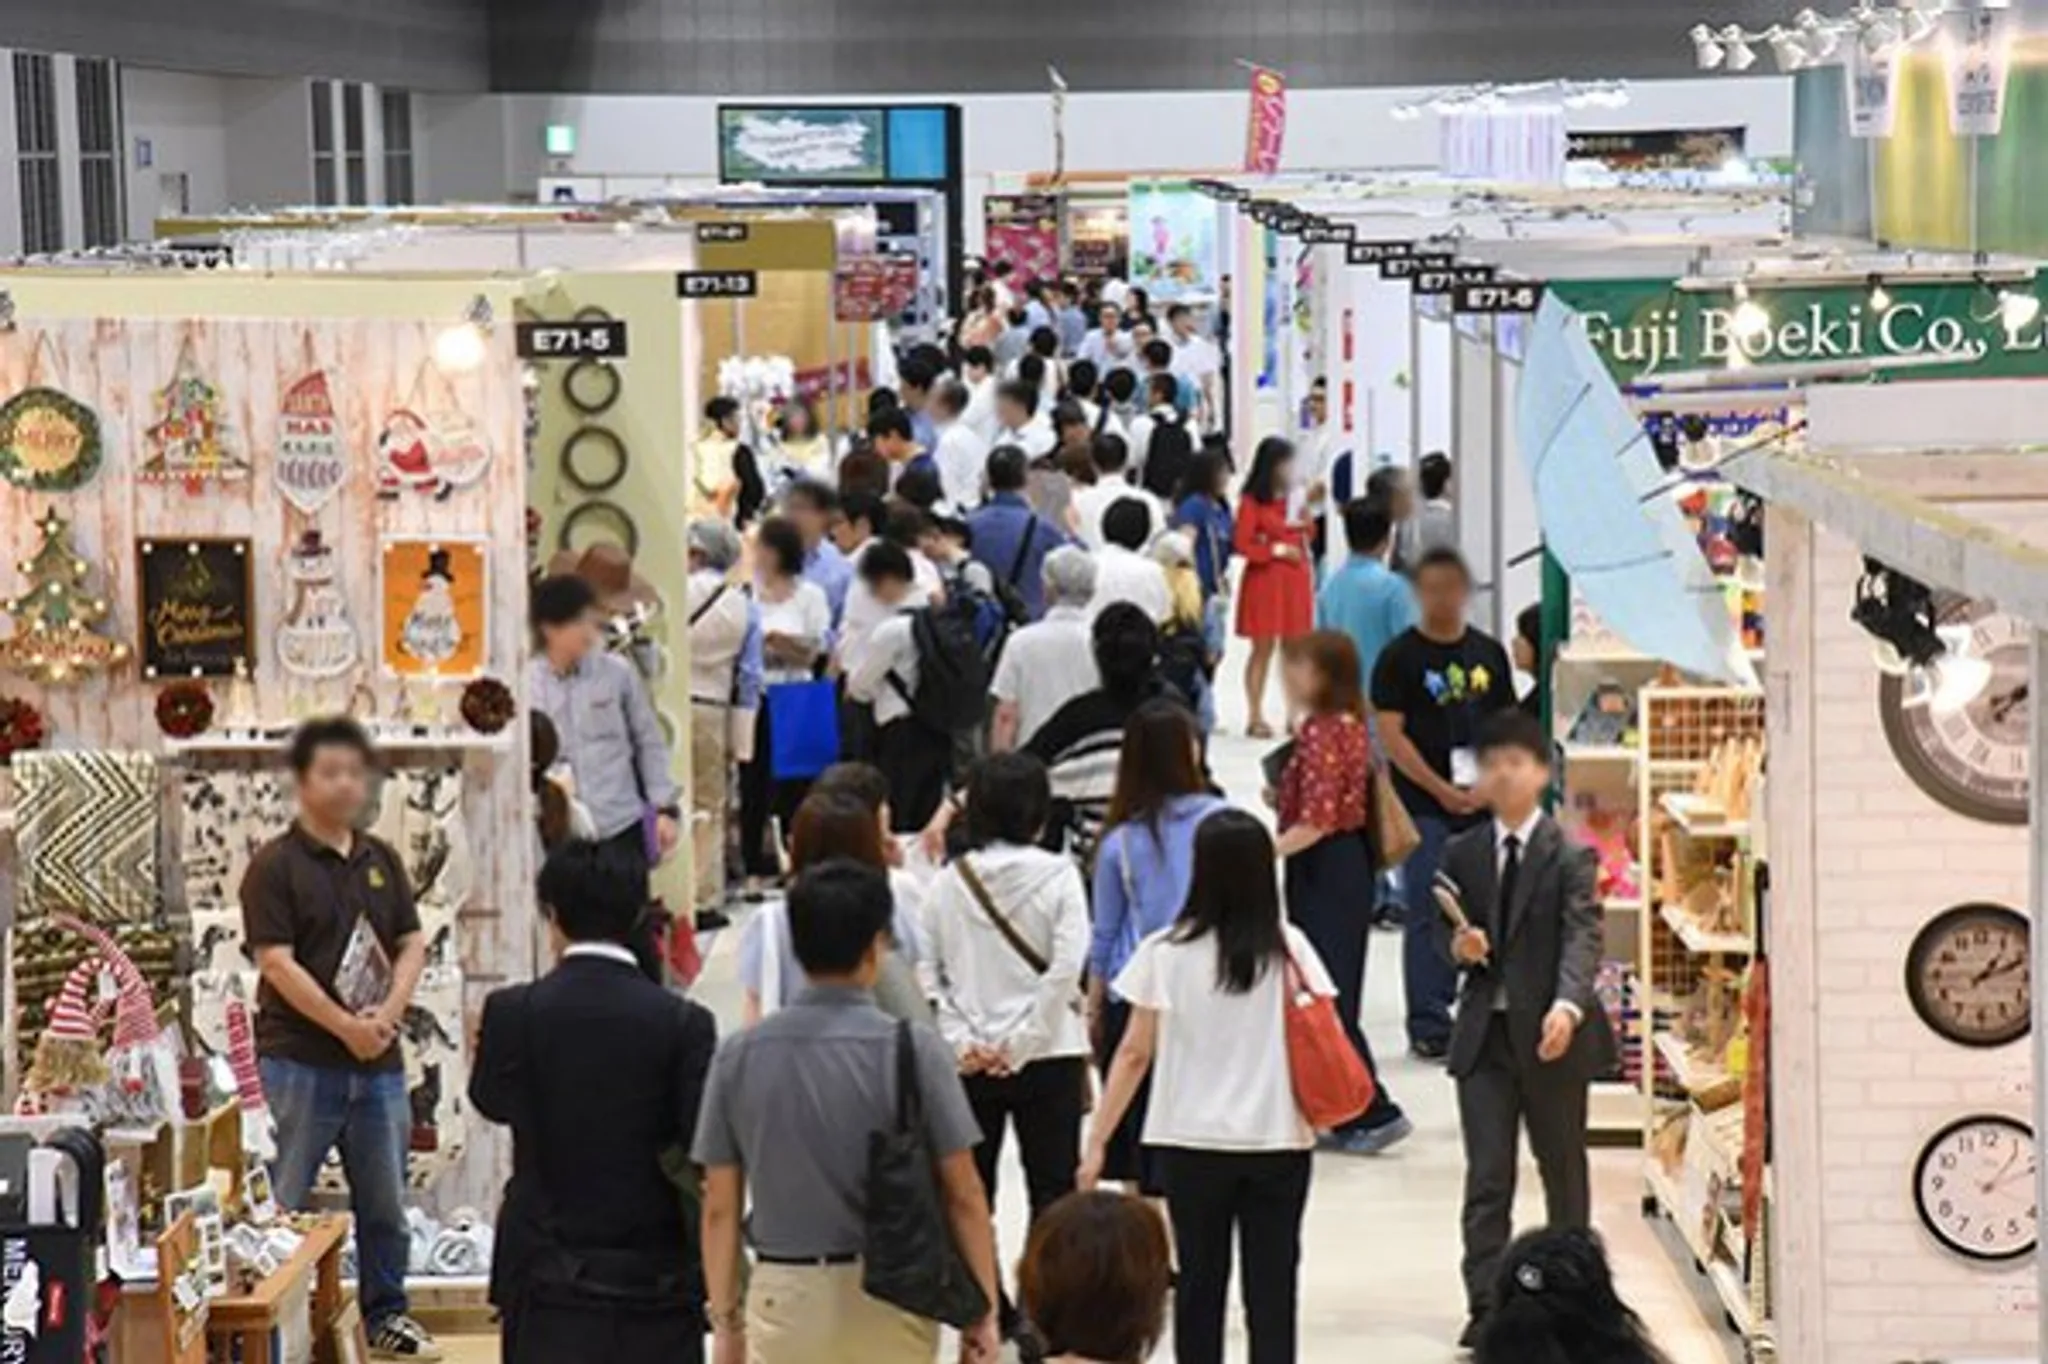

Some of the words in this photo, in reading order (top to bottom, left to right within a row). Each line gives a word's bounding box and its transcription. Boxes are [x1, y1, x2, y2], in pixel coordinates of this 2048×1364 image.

[1466, 287, 1534, 308] E71-6
[533, 328, 611, 352] E71-5
[1578, 309, 1683, 378] Fuji
[1699, 303, 1865, 358] Boeki
